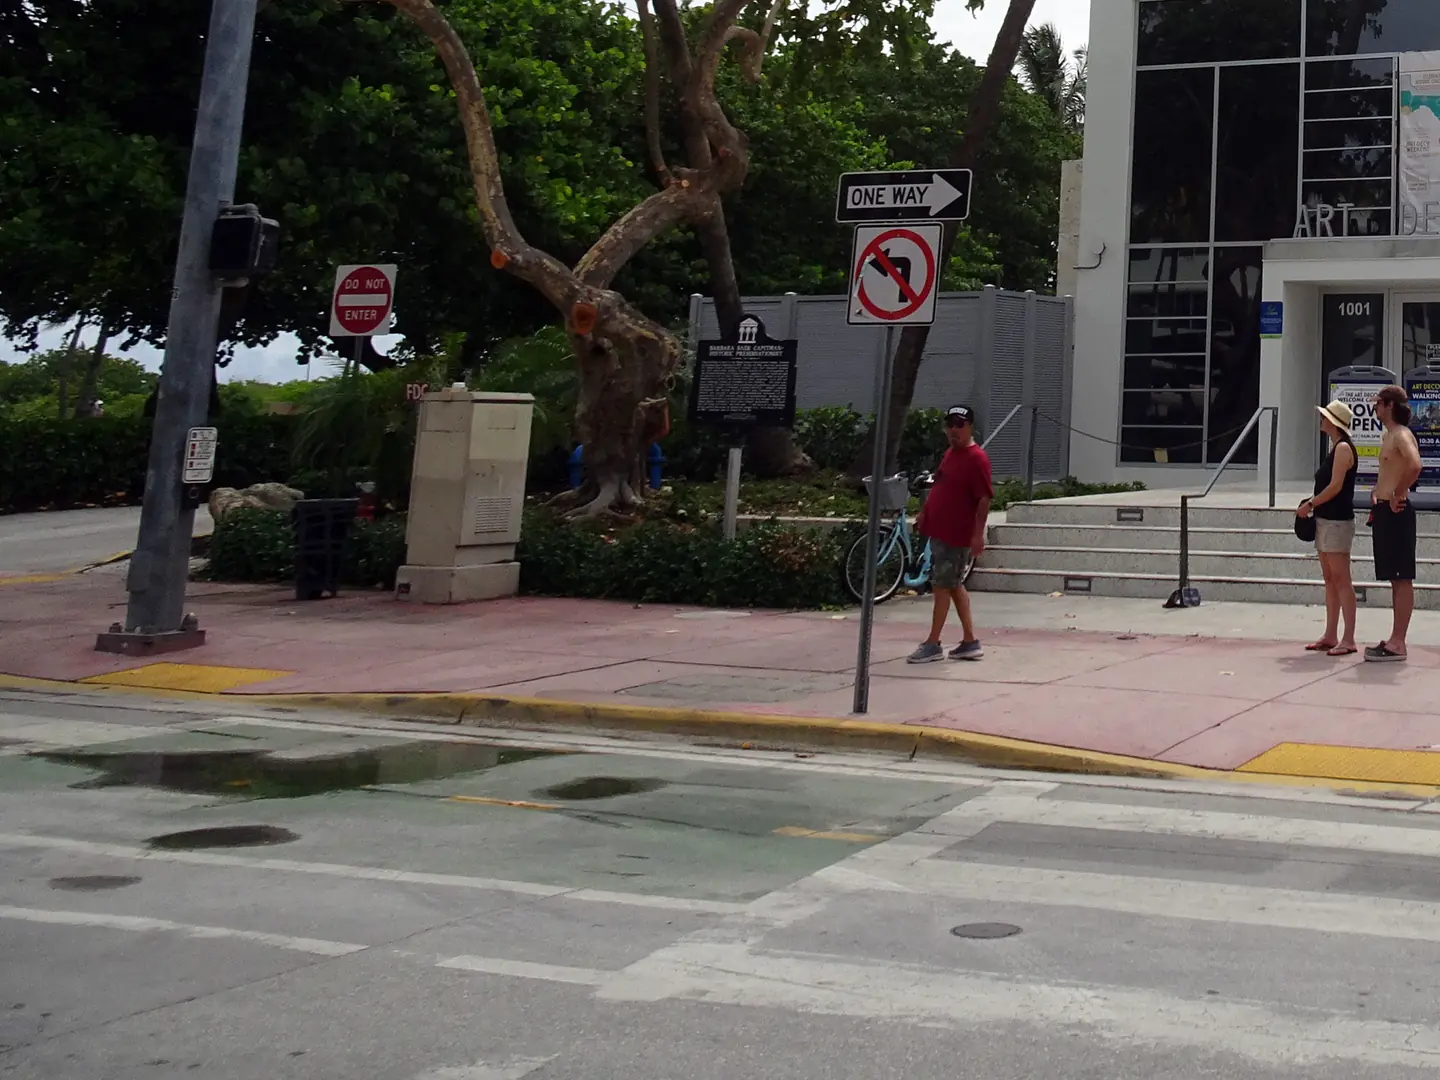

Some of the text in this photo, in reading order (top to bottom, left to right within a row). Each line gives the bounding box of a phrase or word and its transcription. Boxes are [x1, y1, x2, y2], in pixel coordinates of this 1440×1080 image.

[852, 186, 929, 206] ONE WAY
[1293, 203, 1355, 238] ART
[345, 279, 385, 290] DO NOT
[345, 310, 377, 320] ENTER
[1339, 302, 1370, 316] 1001
[1348, 418, 1383, 431] PEN
